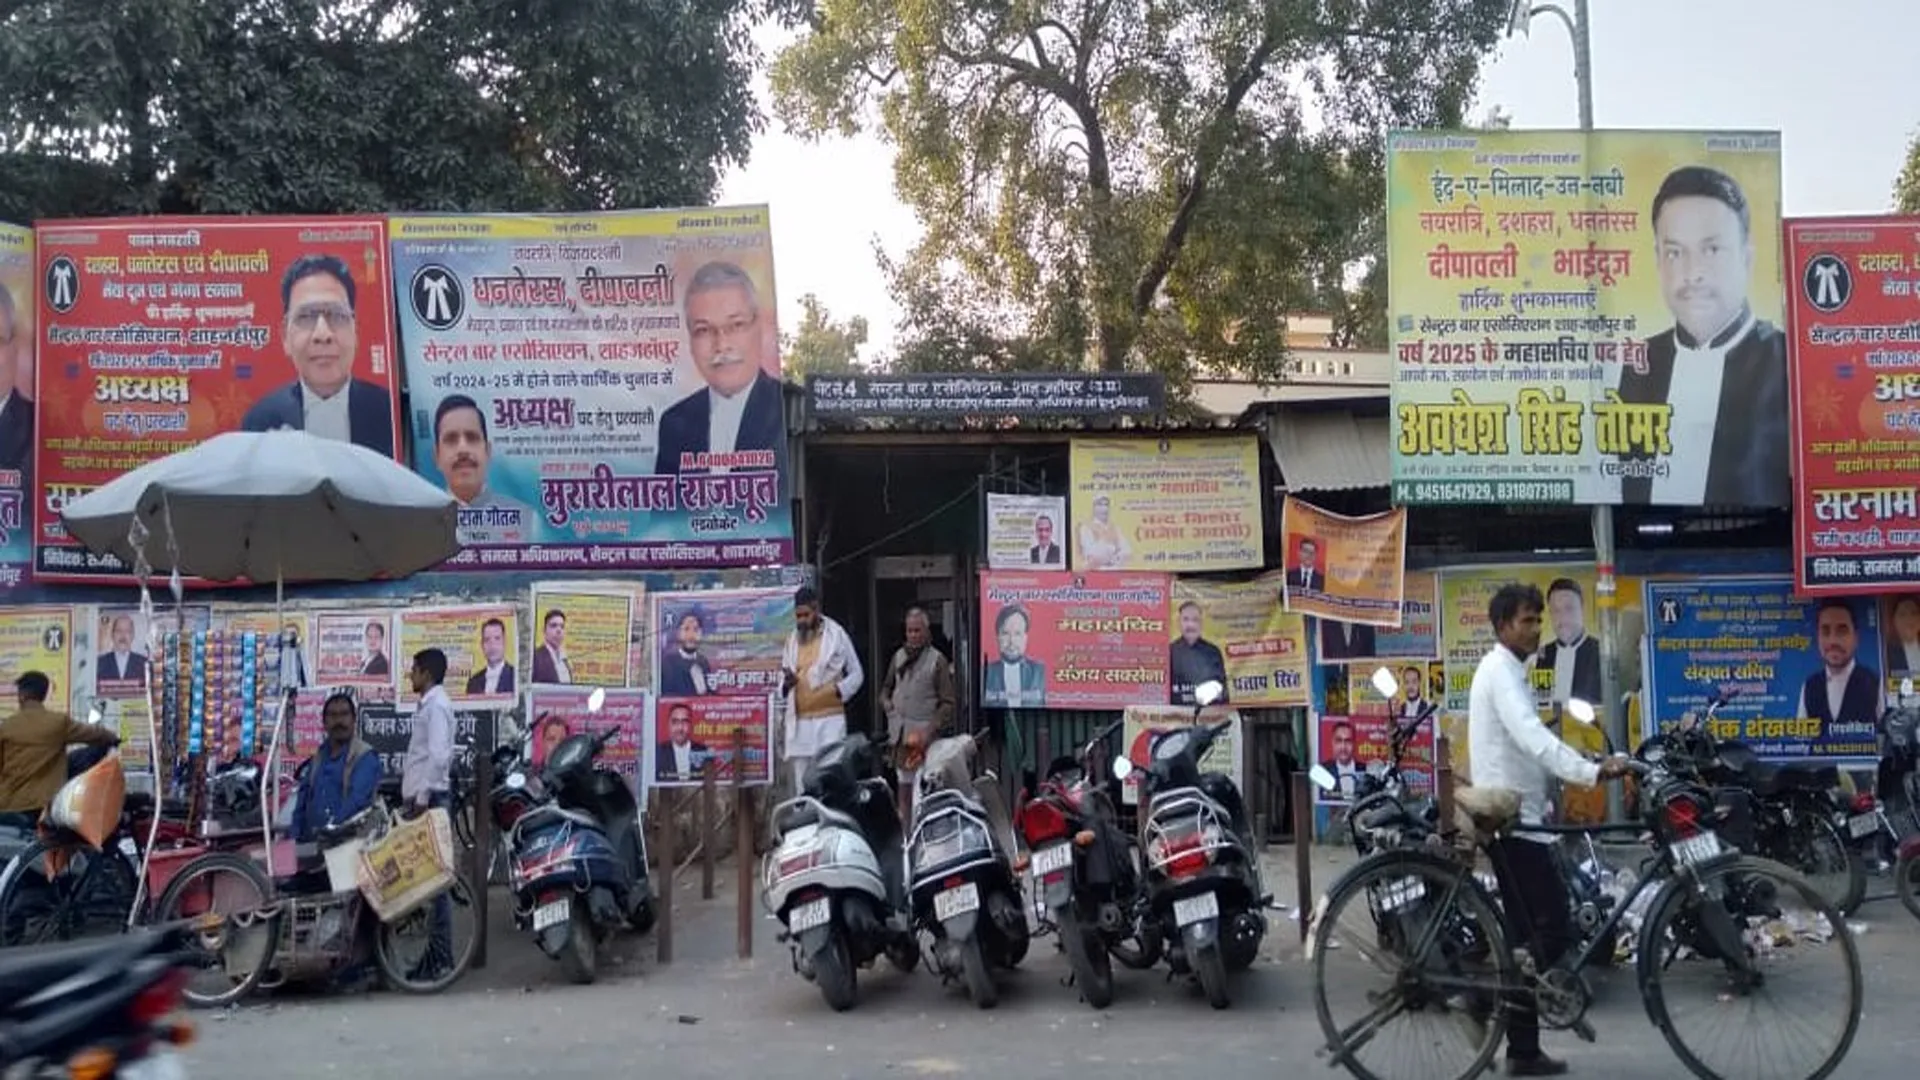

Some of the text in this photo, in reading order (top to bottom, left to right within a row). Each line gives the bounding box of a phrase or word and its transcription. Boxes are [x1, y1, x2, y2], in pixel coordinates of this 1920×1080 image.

[209, 249, 269, 274] दीपावली
[1428, 242, 1518, 279] दीपावली
[576, 262, 675, 306] दीपावली
[1459, 287, 1504, 312] हार्दिक
[1397, 336, 1651, 374] वर्ष 2025 के महासचिव पद हेतु
[94, 373, 191, 404] अध्यक्ष
[454, 374, 510, 388] 2024-25
[552, 370, 579, 388] वाले
[581, 368, 622, 388] वार्षिक
[624, 371, 660, 391] चुनाव
[492, 398, 575, 430] अध्यक्ष
[1516, 387, 1584, 456] सिंह
[1592, 387, 1674, 456] तोमर
[540, 462, 779, 527] मुरारीलाल राजपूत
[1812, 486, 1916, 521] सरनाम
[1055, 664, 1165, 684] संजय सक्सेना
[1733, 661, 1774, 681] सचिव
